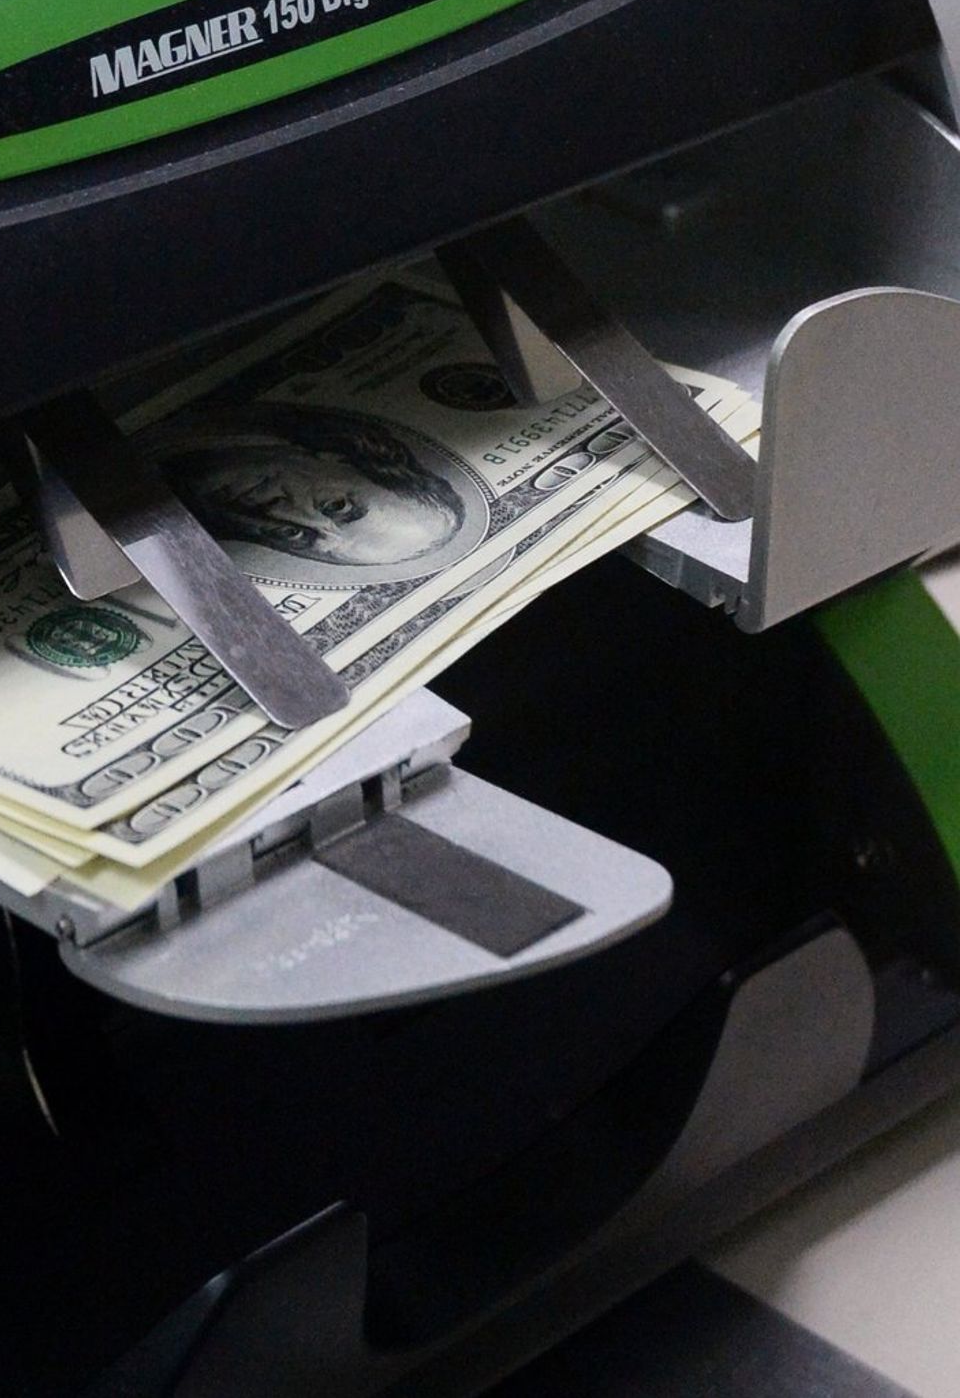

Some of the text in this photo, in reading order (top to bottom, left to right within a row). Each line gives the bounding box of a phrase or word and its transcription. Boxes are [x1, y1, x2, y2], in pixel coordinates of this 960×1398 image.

[90, 6, 262, 98] MAGNER
[496, 462, 535, 488] NOTE
[533, 427, 639, 491] 00
[59, 636, 209, 727] MERICA
